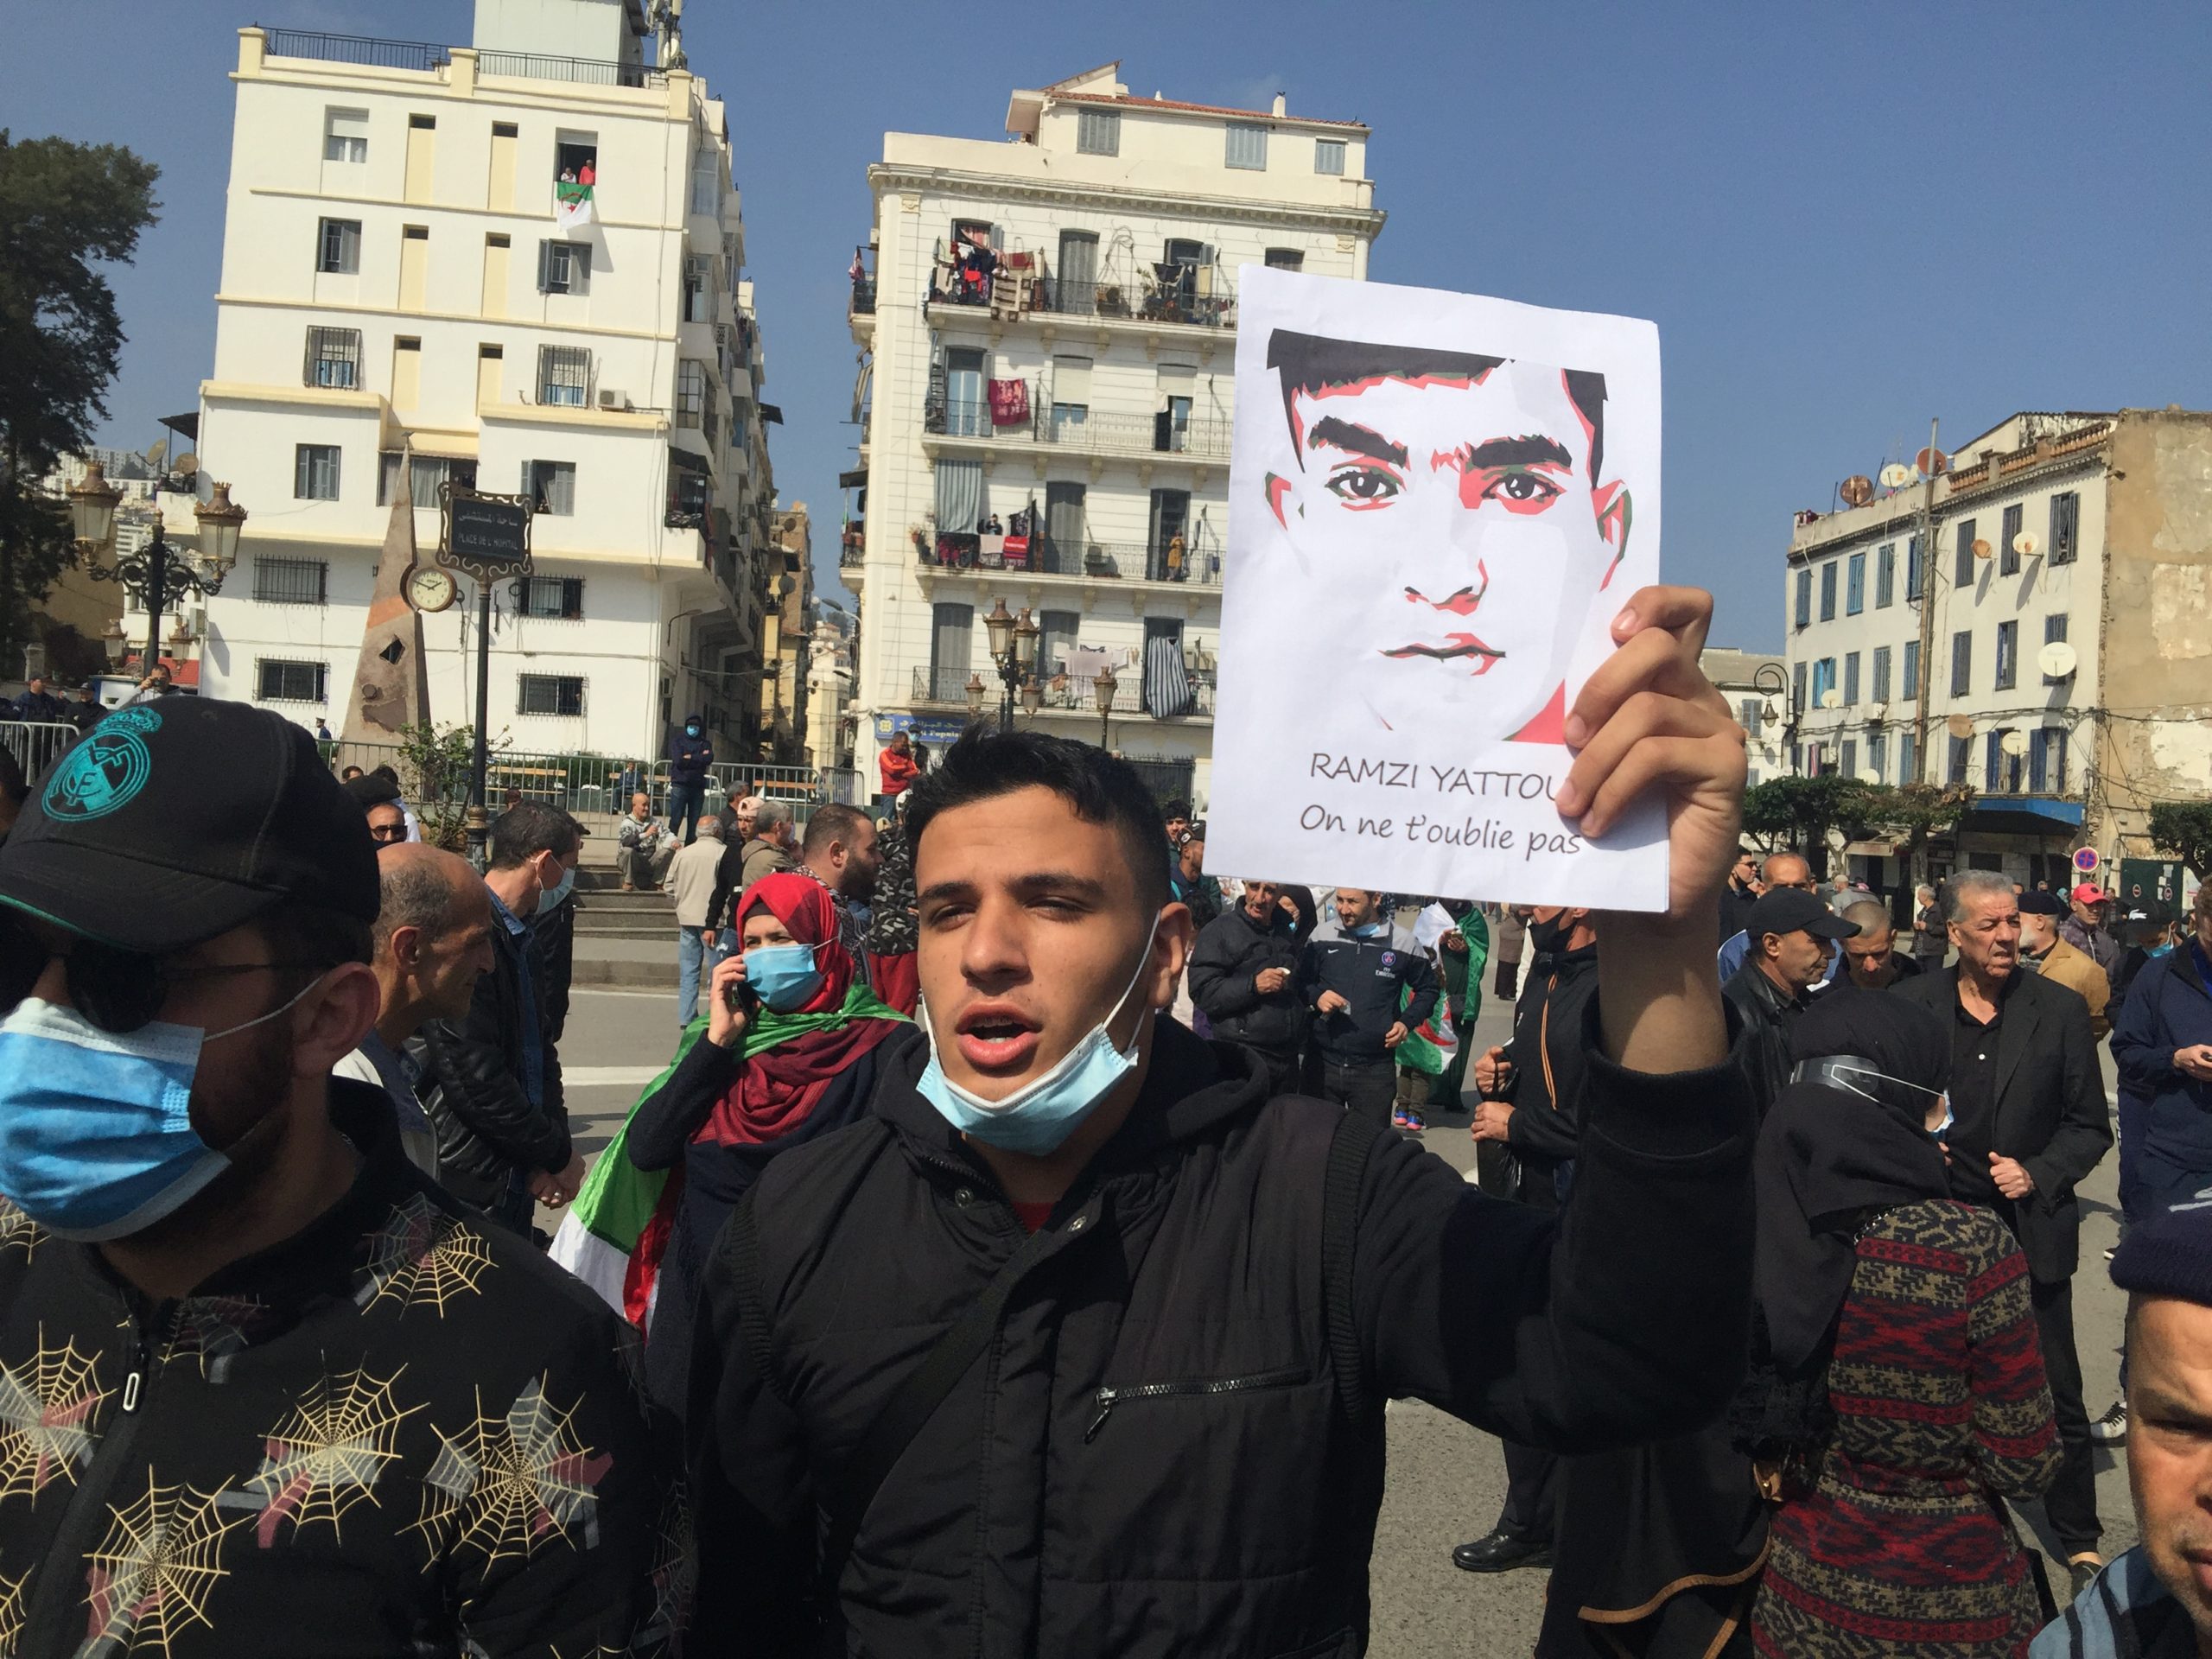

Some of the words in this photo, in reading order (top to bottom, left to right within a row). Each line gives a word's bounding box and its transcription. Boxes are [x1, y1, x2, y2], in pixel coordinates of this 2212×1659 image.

[1311, 753, 1418, 789] RAMZI
[1300, 804, 1346, 830] On
[1357, 817, 1394, 838] ne
[1406, 814, 1515, 849] t'oublie
[1525, 831, 1581, 861] pas
